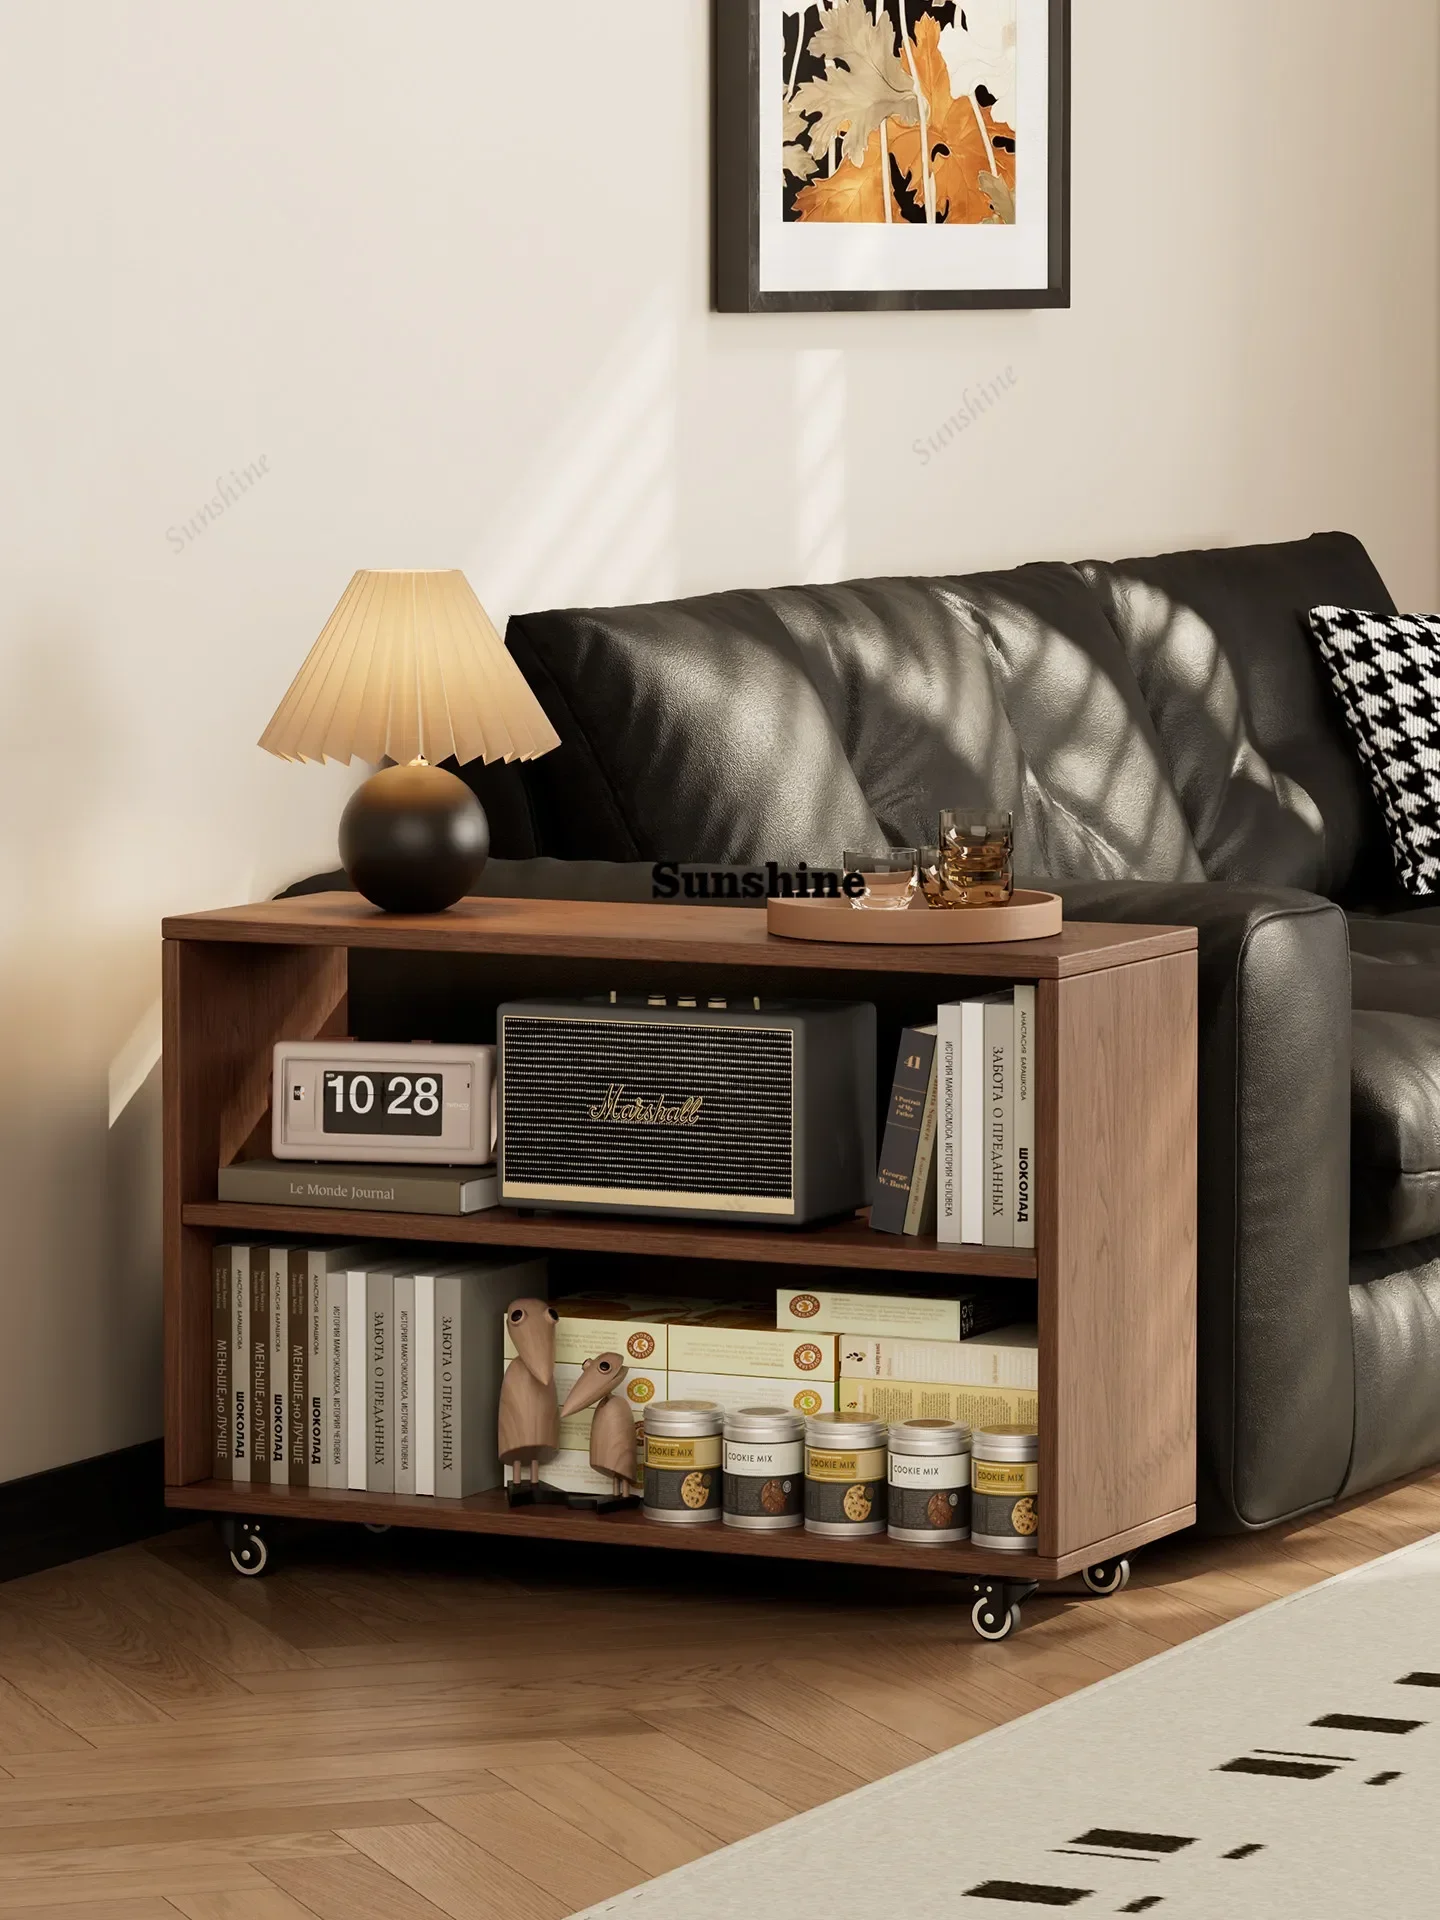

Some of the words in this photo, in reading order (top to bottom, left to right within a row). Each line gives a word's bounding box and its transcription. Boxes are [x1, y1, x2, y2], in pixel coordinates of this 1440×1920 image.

[903, 1055, 921, 1070] 41
[945, 1042, 953, 1075] ИСТОРИЯ
[992, 1047, 1004, 1101] ЗАБОТА
[327, 1075, 374, 1114] 10
[387, 1076, 439, 1116] 28
[588, 1083, 703, 1125] Marshall
[992, 1108, 1003, 1118] О
[882, 1168, 908, 1181] George
[945, 1143, 953, 1177] ИСТОРИЯ
[992, 1123, 1003, 1216] ПРЕДАННЫХ
[290, 1183, 303, 1194] Le
[307, 1184, 348, 1197] Monde
[351, 1186, 394, 1200] Journal
[945, 1179, 953, 1216] ЧЕЛОВЕКА
[1017, 1147, 1029, 1222] ШОКОЛАД
[333, 1306, 341, 1337] ИСТОРИЯ
[374, 1312, 384, 1361] ЗАБОТА
[400, 1311, 409, 1342] ИСТОРИЯ
[442, 1317, 452, 1366] ЗАБОТА
[374, 1367, 384, 1376] О
[442, 1372, 452, 1382] О
[235, 1391, 245, 1458] ШОКОЛАД
[273, 1394, 283, 1461] ШОКОЛАД
[311, 1397, 321, 1464] ШОКОЛАД
[333, 1398, 341, 1429] ИСТОРИЯ
[373, 1381, 384, 1465] ПРЕДАННЫХ
[400, 1403, 409, 1434] ИСТОРИЯ
[441, 1386, 452, 1470] ПРЕДАННЫХ
[216, 1415, 227, 1458] ЛУЧШЕ
[254, 1418, 265, 1461] ЛУЧШЕ
[293, 1420, 303, 1464] ЛУЧШЕ
[400, 1435, 409, 1470] ЧЕЛОВЕКА
[649, 1446, 676, 1456] COOKIE
[677, 1448, 692, 1457] MIX
[728, 1453, 754, 1462] COOKIE
[757, 1454, 772, 1463] MIX
[811, 1458, 836, 1468] COOKIE
[839, 1460, 855, 1469] MIX
[894, 1465, 920, 1475] COOKIE
[978, 1472, 1004, 1481] COOKIE
[1007, 1473, 1023, 1482] MIX
